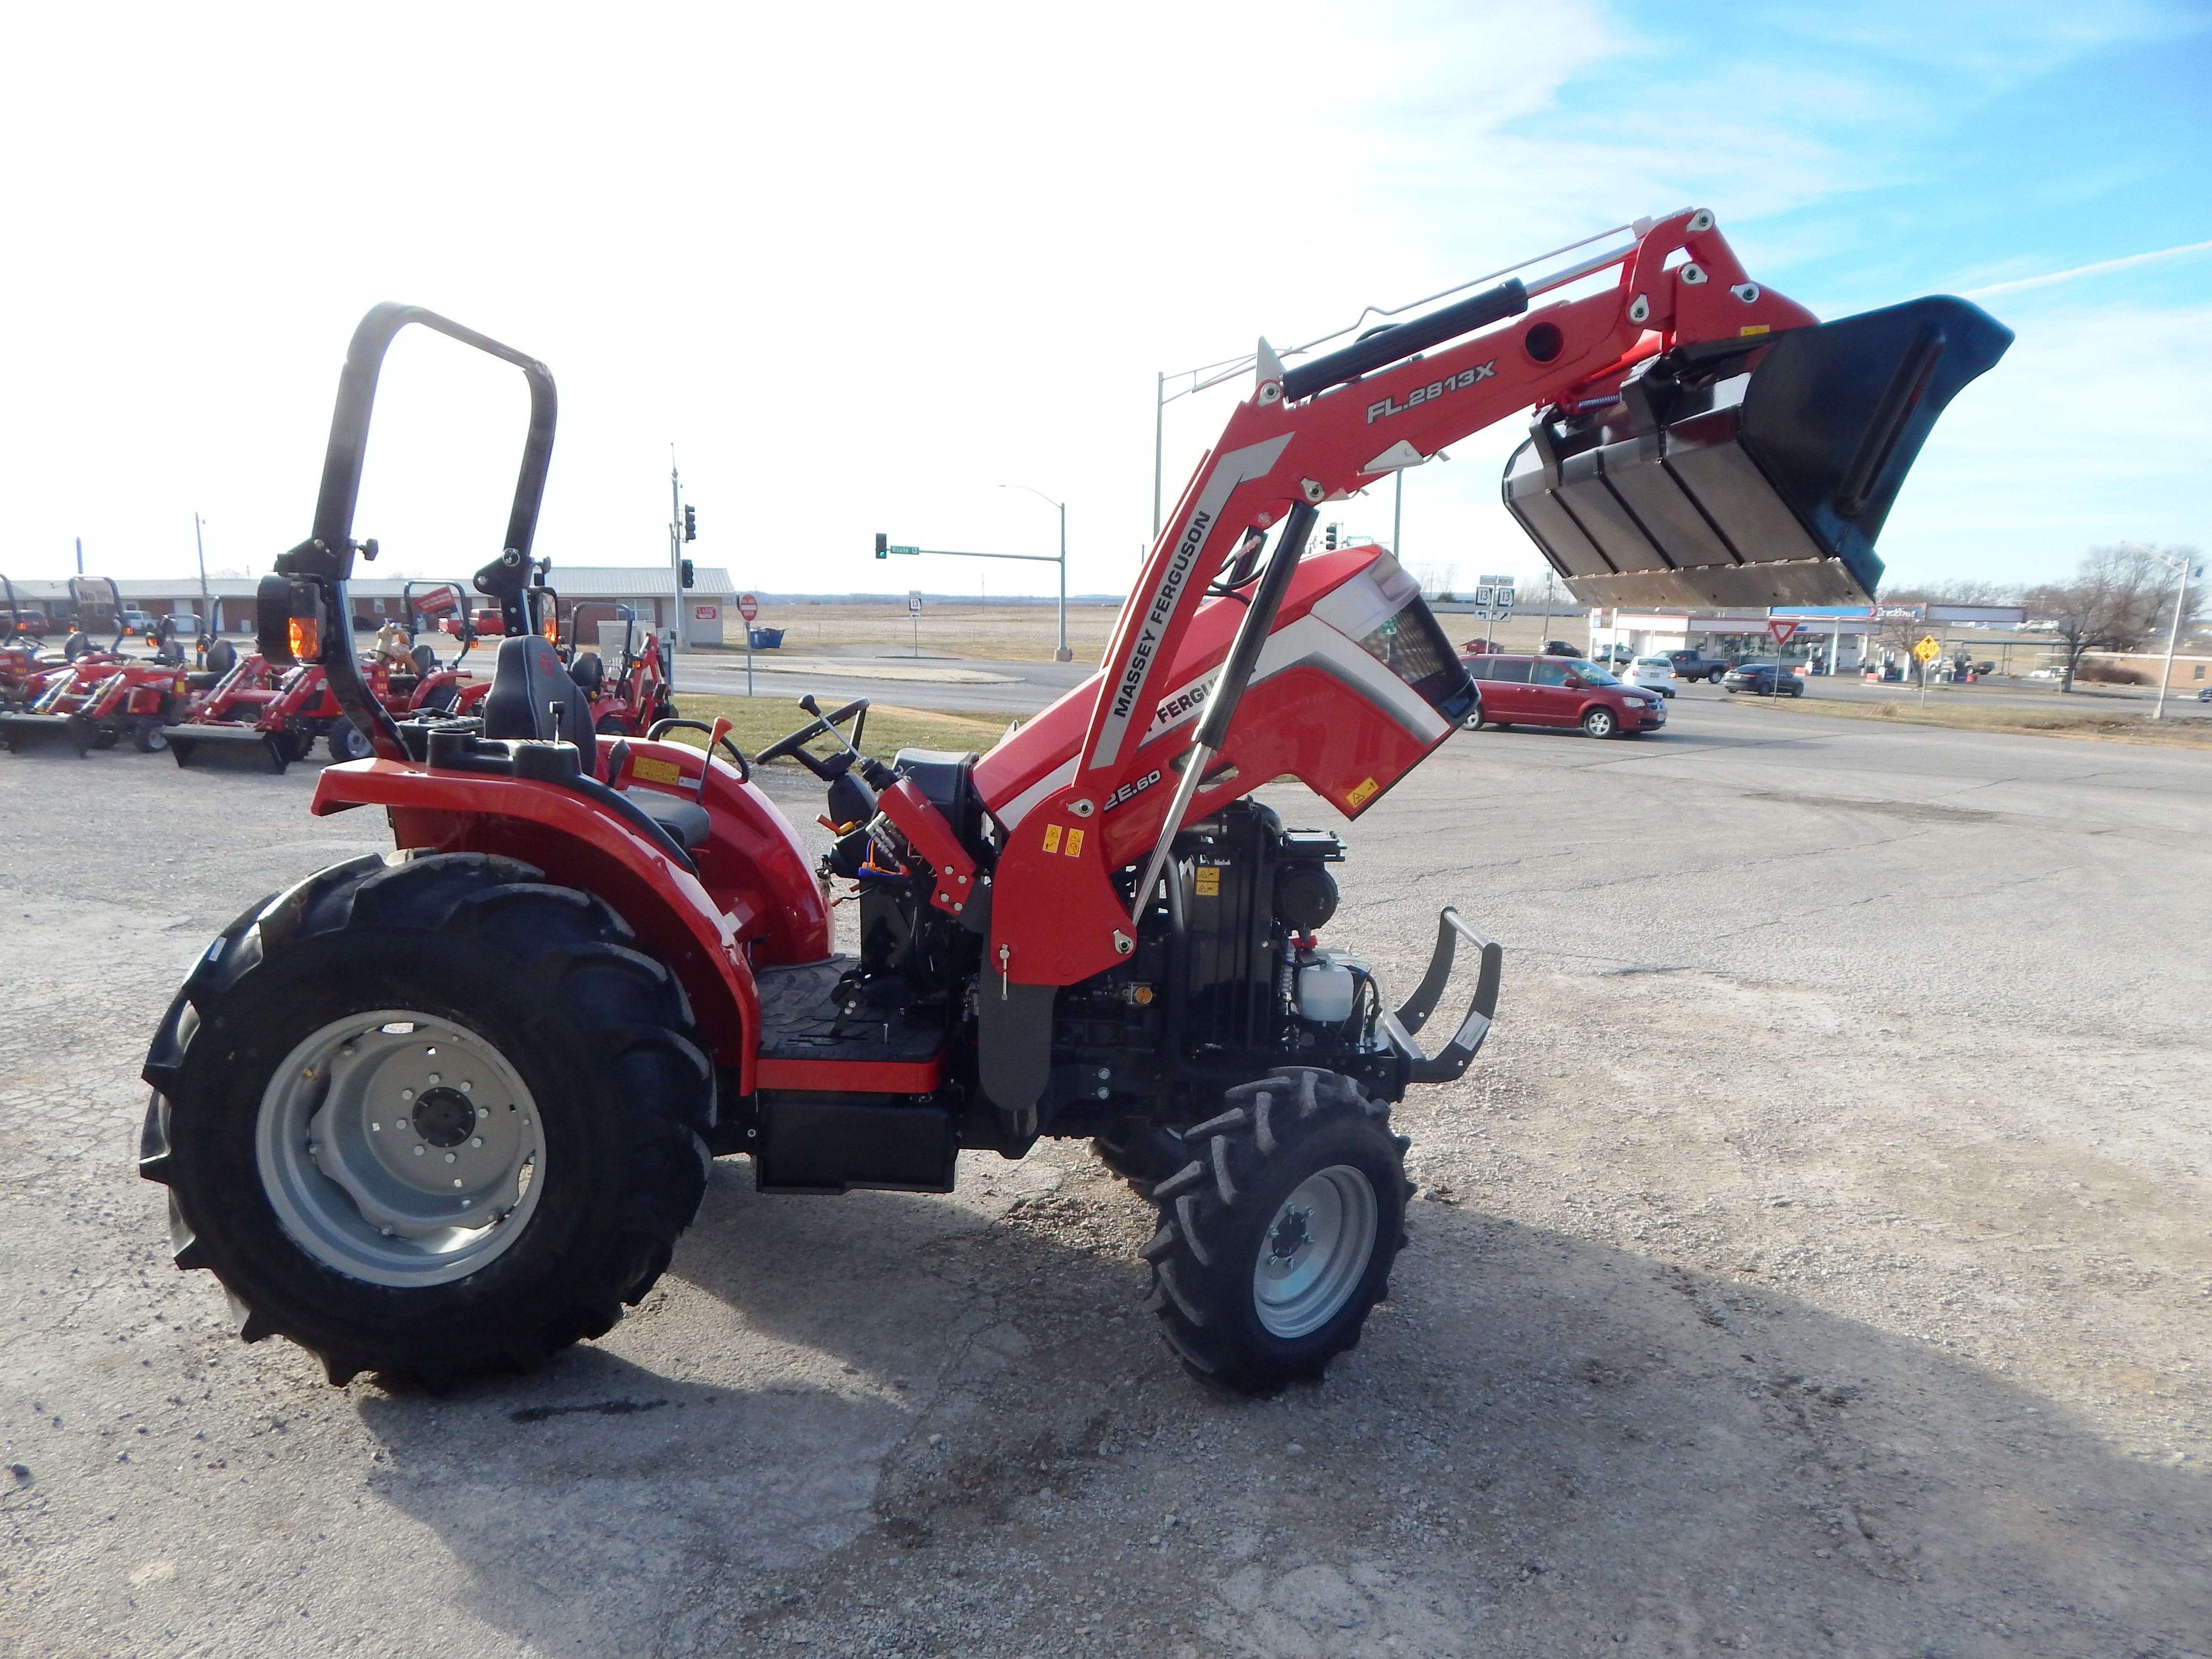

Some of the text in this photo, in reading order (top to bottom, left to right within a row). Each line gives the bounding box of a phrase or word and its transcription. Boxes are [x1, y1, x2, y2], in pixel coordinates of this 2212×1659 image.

[1367, 360, 1495, 425] FL.2813X
[1113, 510, 1211, 718] MASSEY FERGUSON
[1480, 590, 1488, 601] 13
[1503, 591, 1510, 601] 13
